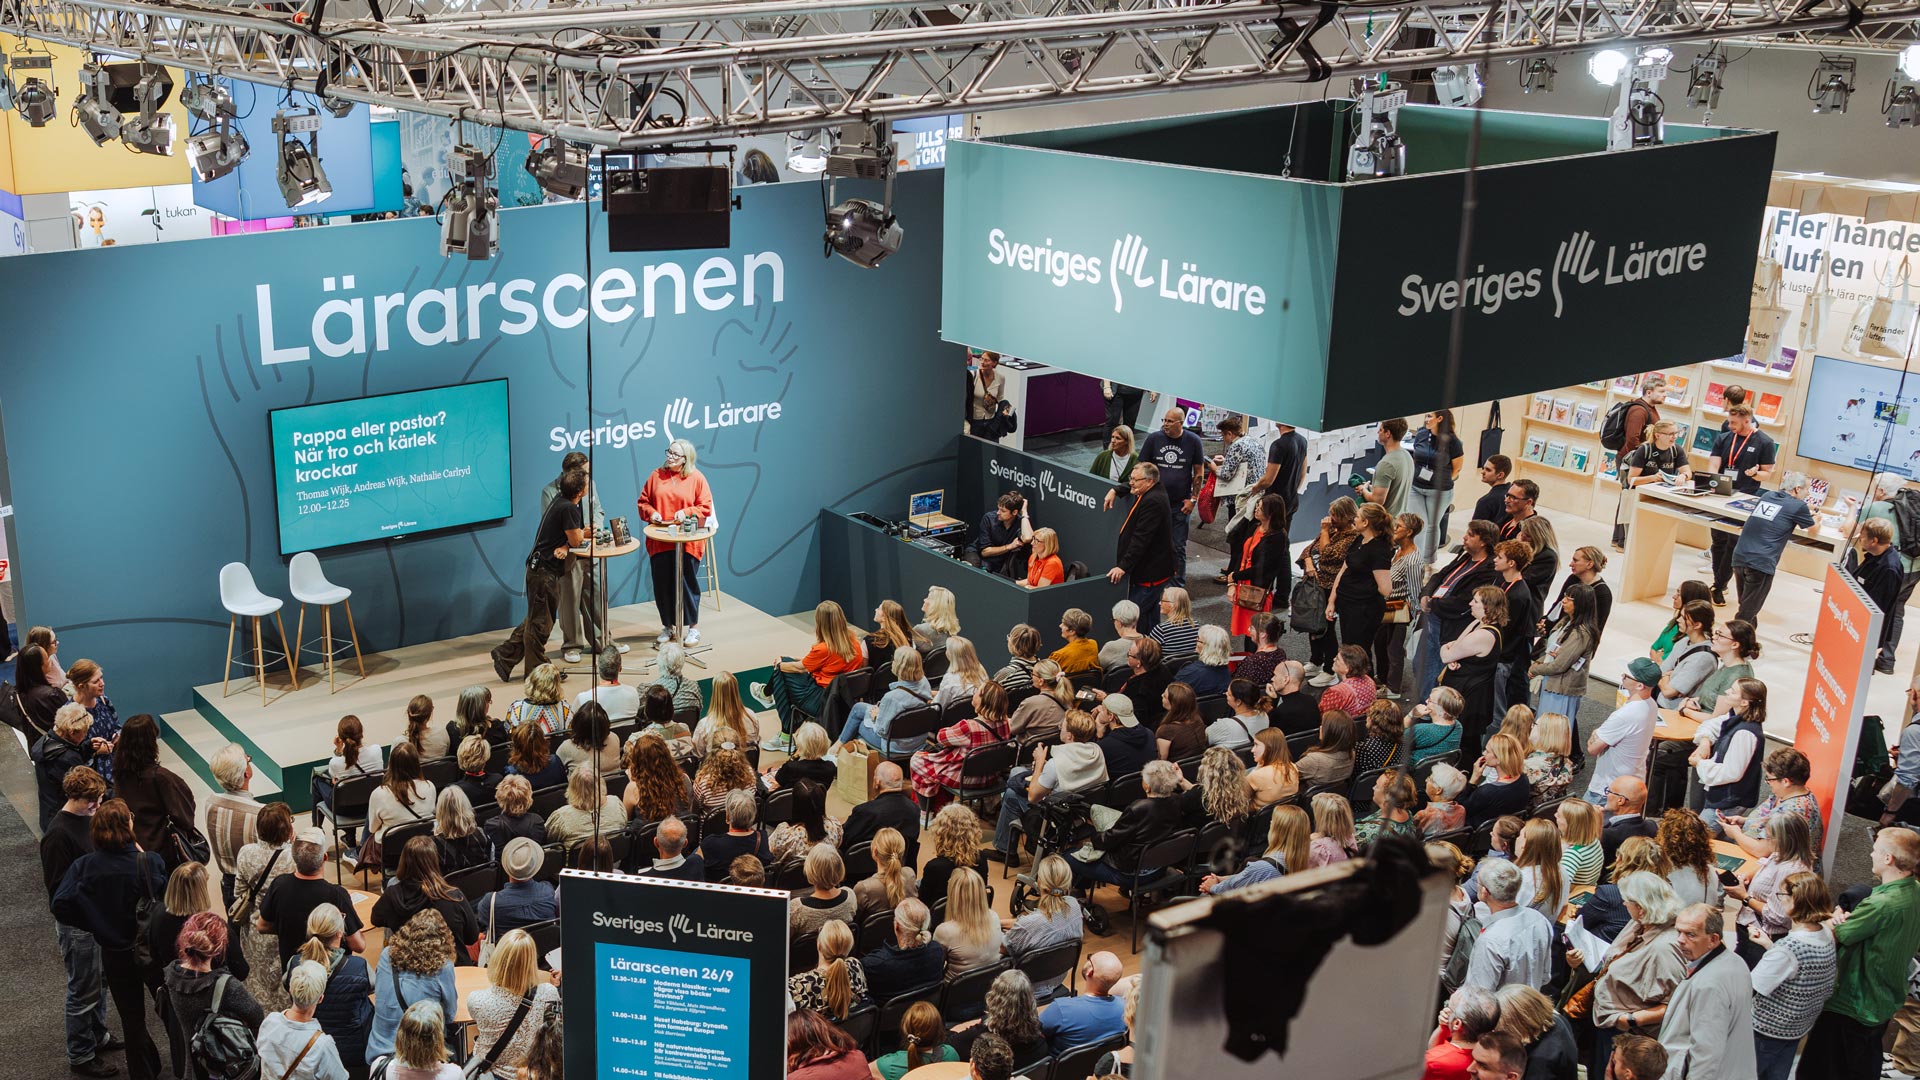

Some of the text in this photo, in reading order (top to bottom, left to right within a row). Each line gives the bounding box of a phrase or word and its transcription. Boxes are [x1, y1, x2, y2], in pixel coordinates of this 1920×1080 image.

[165, 207, 197, 218] tukan
[1775, 210, 1828, 240] Fler
[988, 228, 1266, 316] Sveriges Lärare
[1784, 245, 1865, 280] lufen
[1398, 238, 1707, 317] Sveriges Lärare
[256, 250, 785, 367] Lärarscenen
[1836, 288, 1855, 301] lära
[293, 411, 447, 448] Pappa eller pastor?
[549, 401, 782, 452] Sveriges Lärare
[294, 431, 437, 465] När tro och kärlek
[296, 462, 358, 483] krockar
[296, 465, 471, 501] Thomas Wijk, Andreas Wijk, Nathalie Carlryd
[990, 459, 1097, 509] Sveriges Lärare
[1755, 502, 1777, 519] NE
[592, 911, 754, 943] Sveriges Lärare
[610, 957, 734, 983] Lärarscenen 26/9
[653, 980, 680, 988] Moderna
[682, 982, 708, 991] klassiker
[713, 986, 731, 994] varför
[653, 992, 684, 1000] försvinna?
[675, 988, 689, 996] vissa
[690, 990, 712, 998] böcker
[667, 1024, 693, 1032] formade
[693, 1027, 715, 1035] Europa
[671, 1018, 702, 1028] Habsburg:
[702, 1021, 729, 1031] Dynastin
[711, 1055, 732, 1063] skolan
